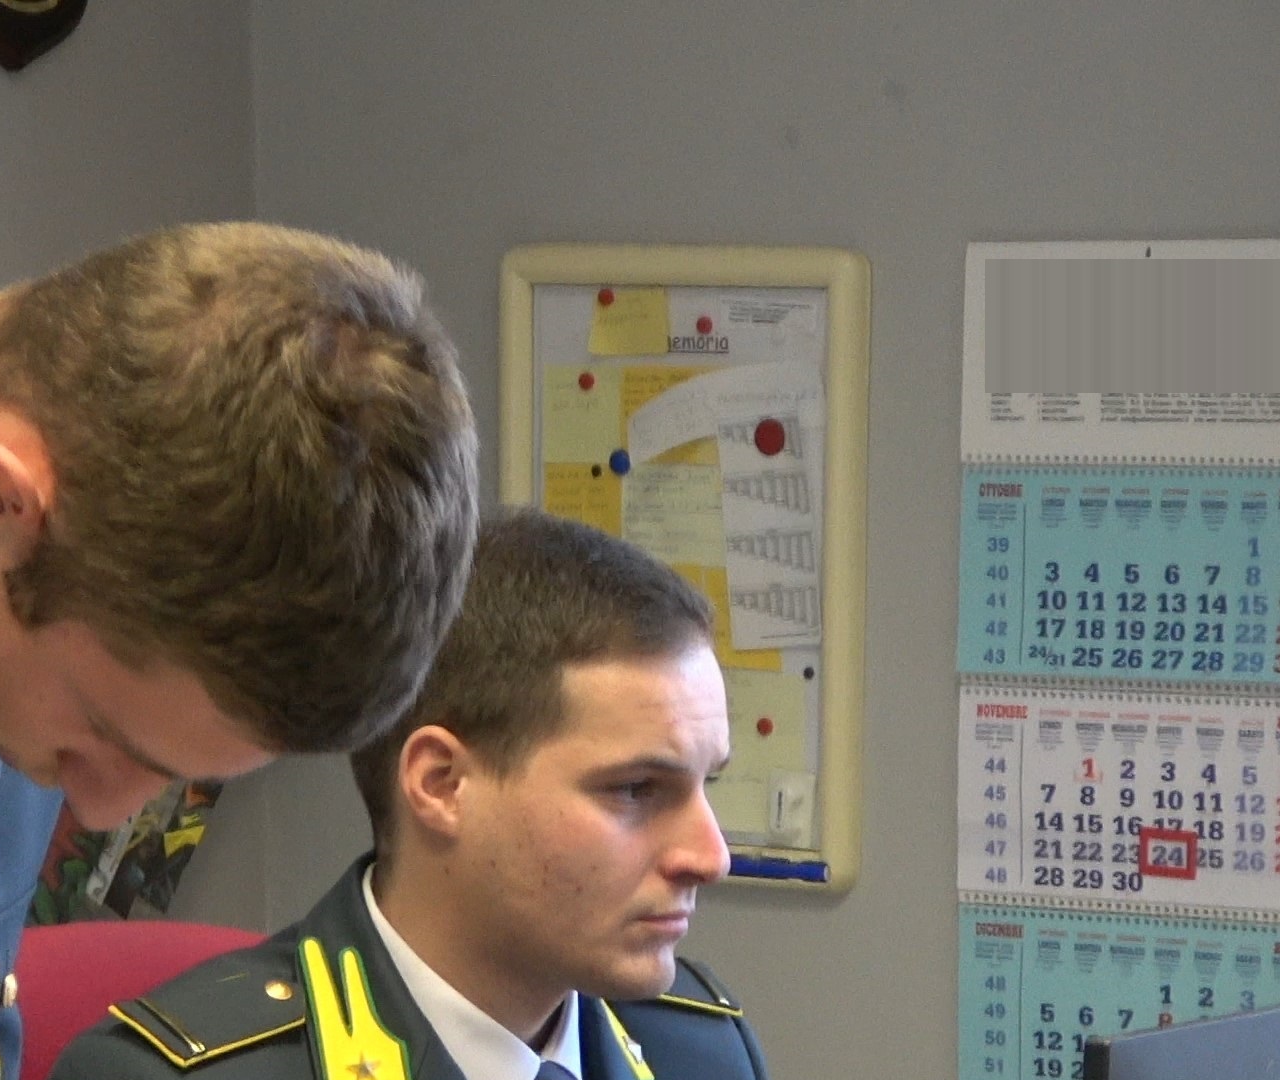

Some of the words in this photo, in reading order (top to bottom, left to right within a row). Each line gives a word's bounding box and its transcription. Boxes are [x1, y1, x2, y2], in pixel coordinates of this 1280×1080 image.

[987, 537, 1009, 553] 39
[1248, 537, 1259, 558] 1
[986, 565, 1009, 581] 40
[1045, 562, 1059, 583] 3
[1084, 563, 1099, 582] 4
[1125, 564, 1139, 584] 5
[1165, 565, 1179, 584] 6
[1205, 565, 1220, 585] 7
[1245, 566, 1261, 586] 8
[986, 593, 1006, 608] 41
[1037, 590, 1066, 610] 10
[1077, 591, 1104, 611] 11
[1117, 592, 1146, 612] 12
[1157, 593, 1186, 613] 13
[1197, 594, 1227, 614] 14
[1238, 595, 1268, 616] 15
[985, 620, 1007, 636] 42
[1036, 618, 1065, 638] 17
[1076, 620, 1104, 640] 18
[1116, 620, 1145, 640] 19
[1154, 621, 1185, 641] 20
[1194, 622, 1224, 643] 21
[1235, 622, 1266, 644] 22
[983, 648, 1005, 664] 43
[1072, 646, 1103, 668] 25
[1111, 648, 1142, 668] 26
[1151, 649, 1184, 670] 27
[1192, 651, 1224, 672] 28
[1232, 652, 1264, 673] 29
[977, 704, 1027, 719] NOVEMBRE
[985, 758, 1006, 773] 44
[1082, 758, 1094, 778] 1
[1120, 760, 1135, 779] 2
[1161, 762, 1175, 782] 3
[1201, 764, 1216, 784] 4
[1242, 766, 1257, 786] 5
[984, 785, 1005, 801] 45
[1041, 784, 1056, 803] 7
[1080, 786, 1095, 806] 8
[1120, 788, 1135, 808] 9
[1153, 790, 1183, 810] 10
[1194, 792, 1222, 813] 11
[1235, 793, 1265, 815] 12
[985, 813, 1006, 830] 46
[1035, 812, 1063, 831] 14
[1073, 814, 1103, 834] 15
[1113, 815, 1144, 837] 16
[1194, 819, 1224, 841] 18
[1235, 822, 1265, 843] 19
[985, 840, 1006, 856] 47
[1034, 839, 1062, 859] 21
[1072, 841, 1103, 862] 22
[1112, 843, 1140, 865] 23
[1152, 846, 1183, 867] 24
[1196, 848, 1224, 870] 25
[1233, 850, 1265, 872] 26
[985, 868, 1007, 883] 48
[1034, 866, 1064, 887] 28
[1073, 869, 1103, 889] 29
[1112, 872, 1144, 893] 30
[985, 976, 1005, 991] 48
[1160, 985, 1171, 1005] 1
[1198, 987, 1213, 1008] 2
[1240, 990, 1256, 1011] 3
[984, 1003, 1005, 1019] 49
[1040, 1003, 1054, 1023] 5
[1079, 1006, 1093, 1027] 6
[1118, 1009, 1133, 1029] 7
[985, 1030, 1006, 1046] 50
[1033, 1030, 1062, 1050] 12
[985, 1057, 1003, 1074] 51
[1034, 1058, 1062, 1078] 19
